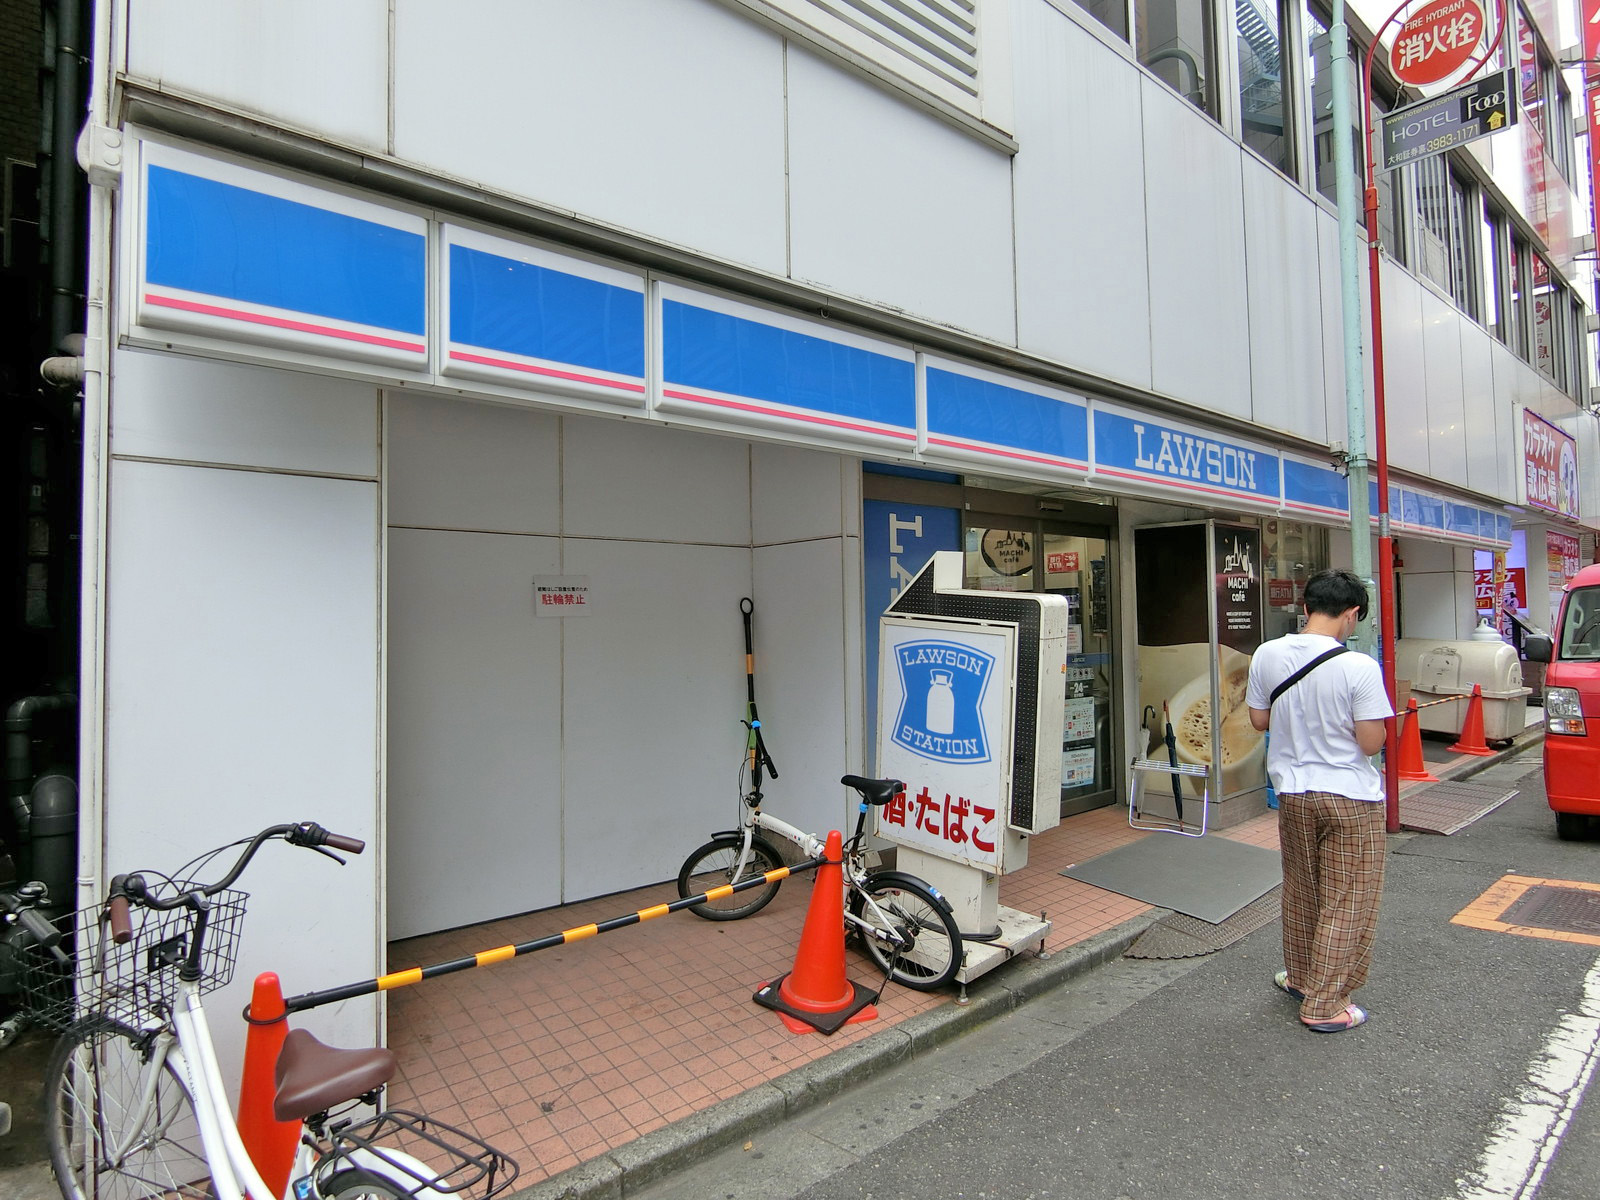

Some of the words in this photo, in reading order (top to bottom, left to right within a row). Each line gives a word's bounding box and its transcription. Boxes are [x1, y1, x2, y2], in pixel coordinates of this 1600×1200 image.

[1404, 16, 1424, 33] FIRE
[1425, 0, 1466, 24] HYDRANT
[1398, 12, 1476, 71] 消火栓
[1392, 110, 1459, 144] HOTEL
[1426, 123, 1479, 152] 3983-1171
[1134, 424, 1257, 490] LAWSON
[1525, 418, 1556, 466] カラオケ
[1526, 460, 1557, 506] 歌広場
[541, 593, 586, 605] 駐輪禁止
[1227, 576, 1249, 589] MACHI
[903, 648, 985, 677] LAWSON
[901, 724, 979, 756] STATION
